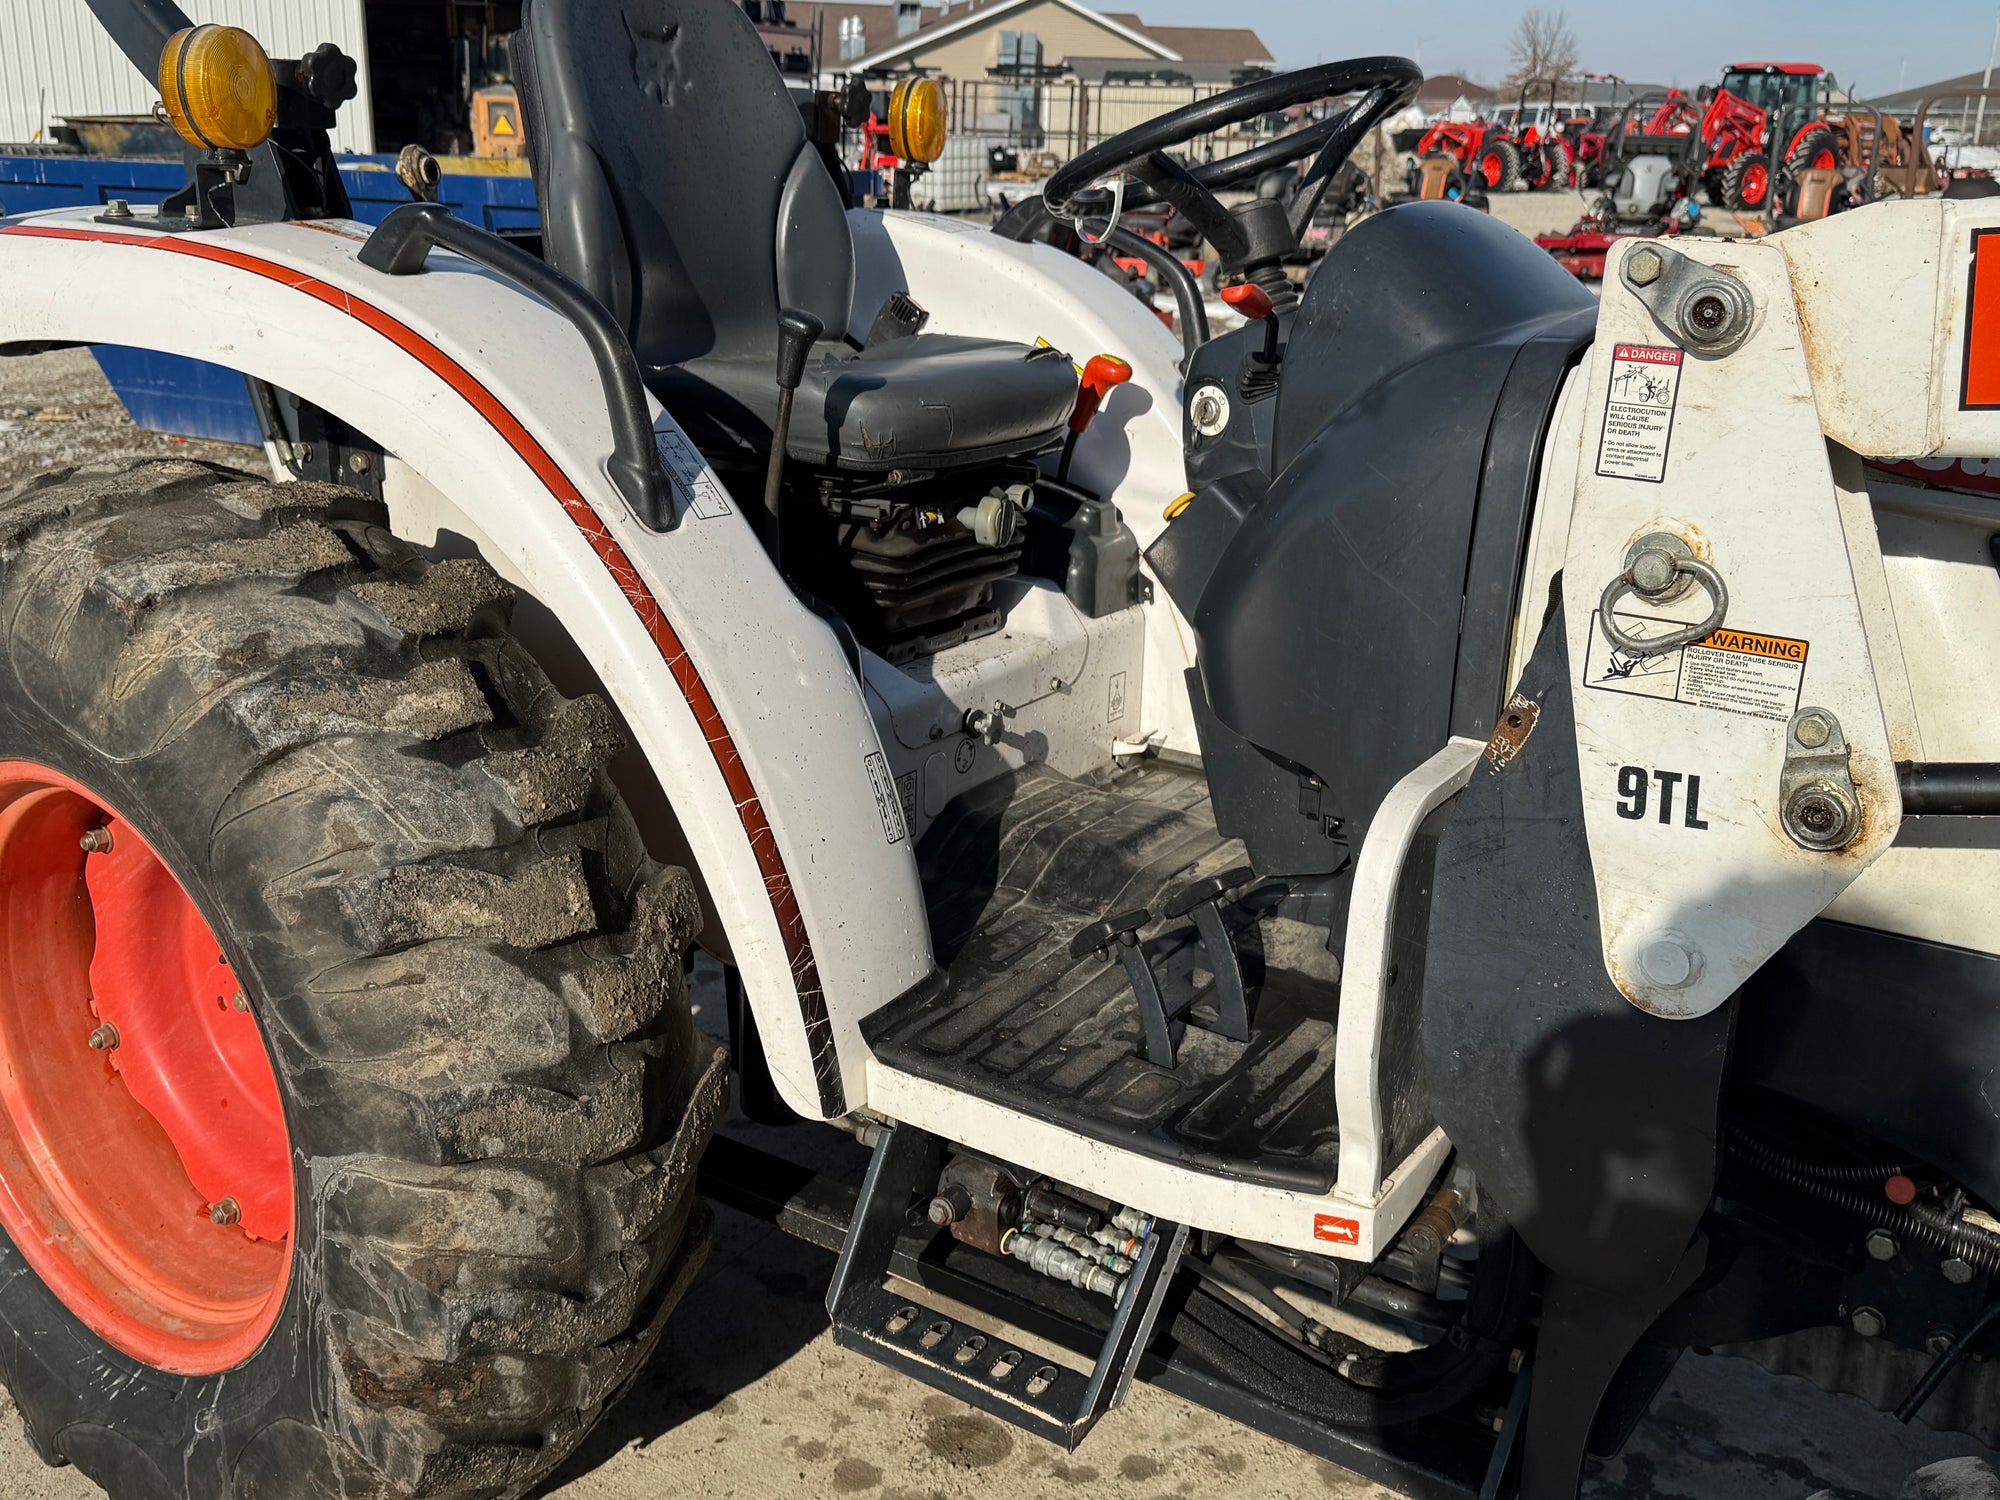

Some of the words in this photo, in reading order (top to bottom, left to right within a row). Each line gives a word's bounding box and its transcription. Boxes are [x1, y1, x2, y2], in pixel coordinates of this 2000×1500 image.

[1631, 349, 1677, 362] DANGER
[1610, 406, 1666, 416] ELECTROCUTION
[1711, 632, 1800, 658] WARNING
[1687, 653, 1712, 661] INJURY
[1688, 648, 1724, 657] ROLLOVER
[1743, 656, 1766, 665] CAUSE
[1768, 660, 1798, 670] SERIOUS
[1616, 766, 1708, 830] 9TL
